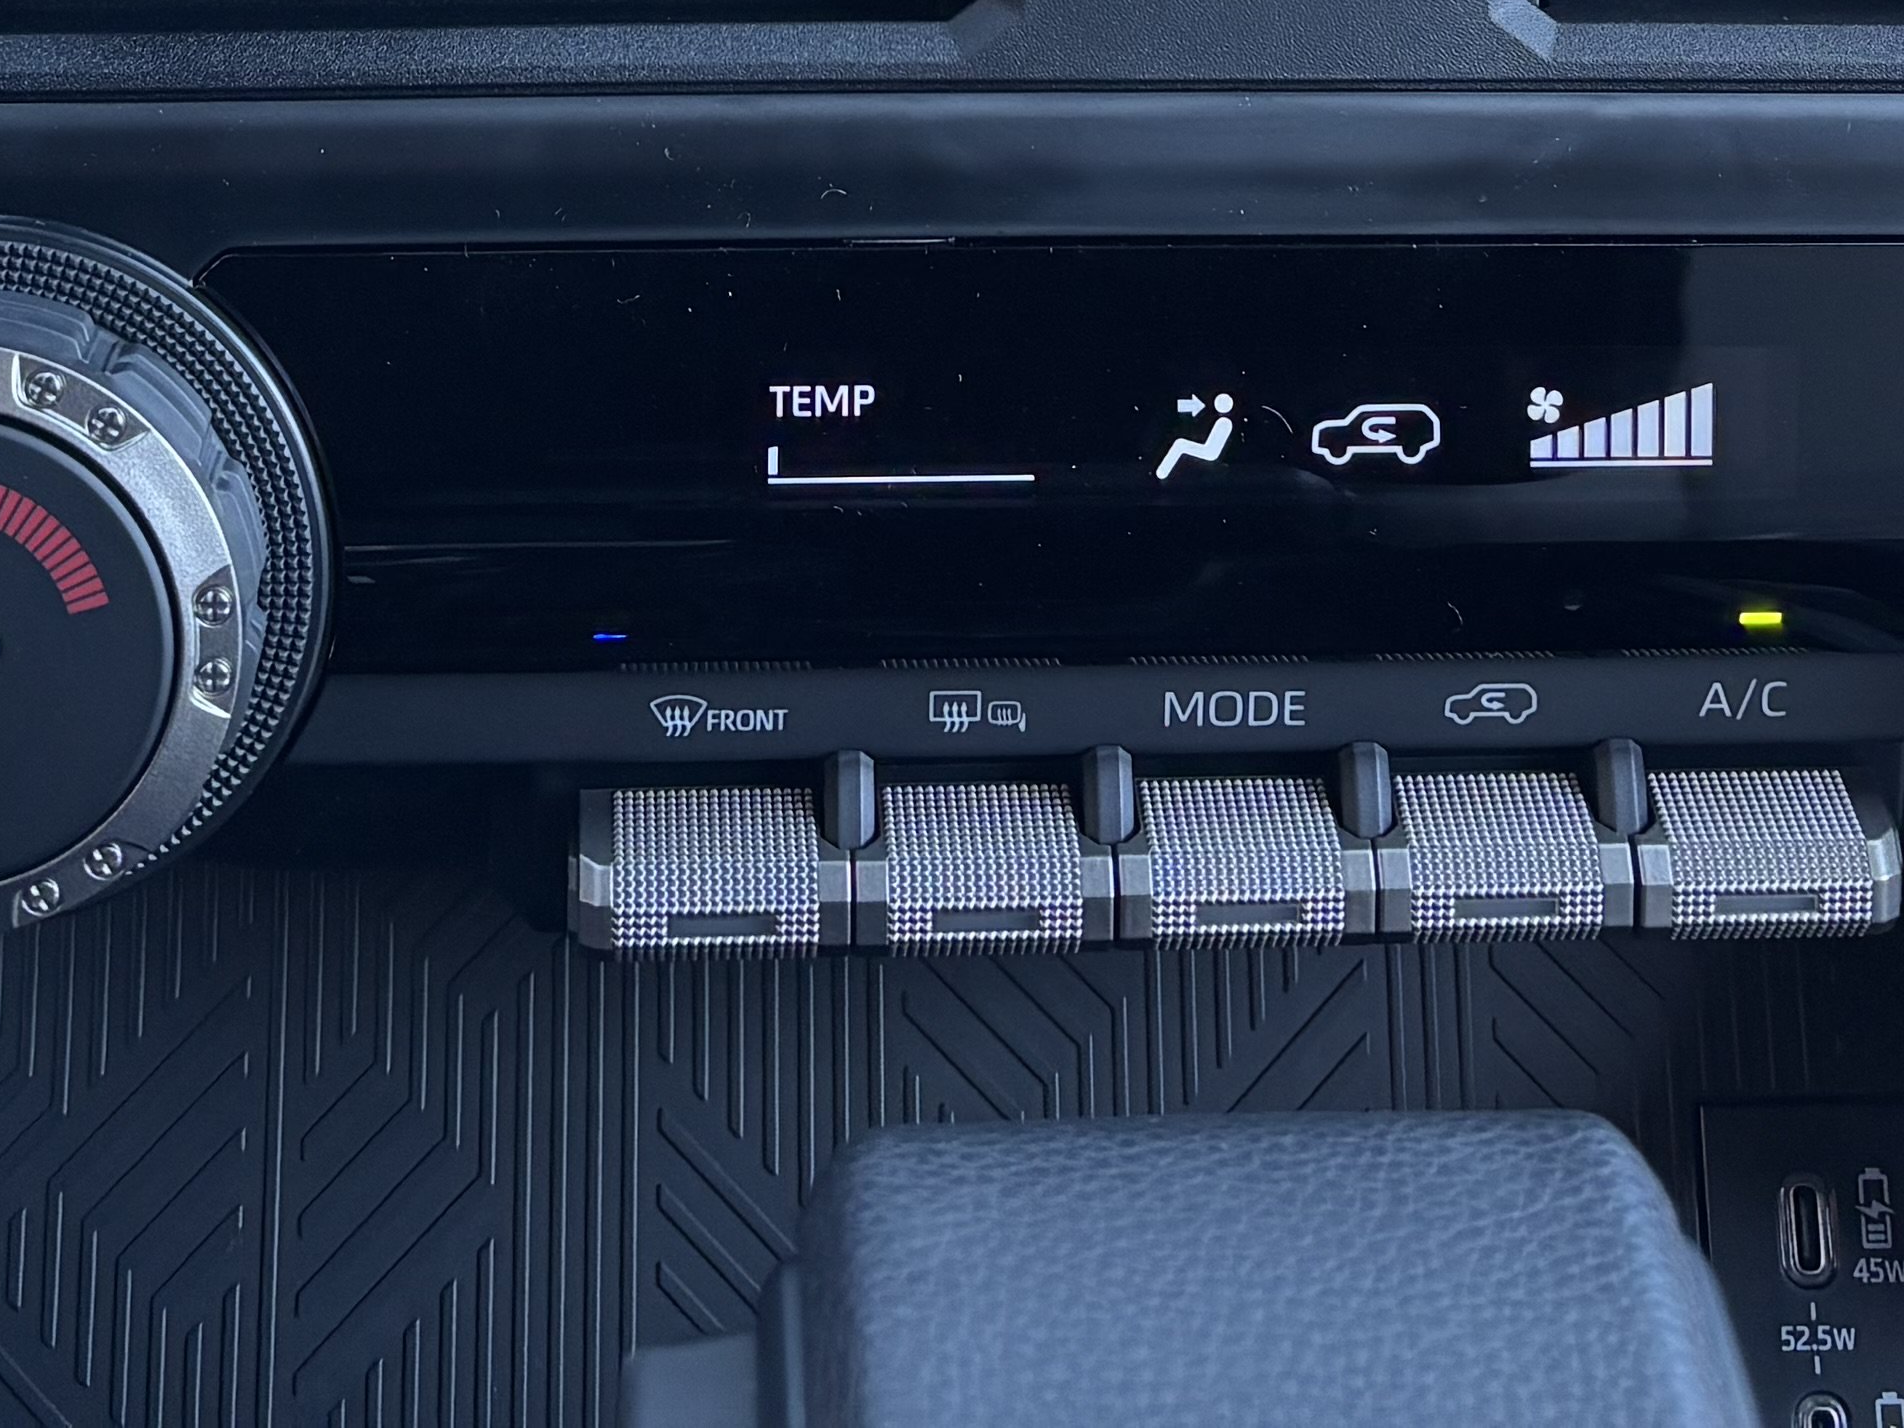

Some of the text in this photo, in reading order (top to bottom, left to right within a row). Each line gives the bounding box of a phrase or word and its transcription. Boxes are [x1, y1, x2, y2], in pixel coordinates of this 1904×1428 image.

[769, 384, 876, 418] TEMP
[1163, 690, 1307, 727] MODE
[1699, 680, 1787, 721] A/C
[706, 707, 788, 732] FRONT
[1781, 1325, 1855, 1351] 52.5W
